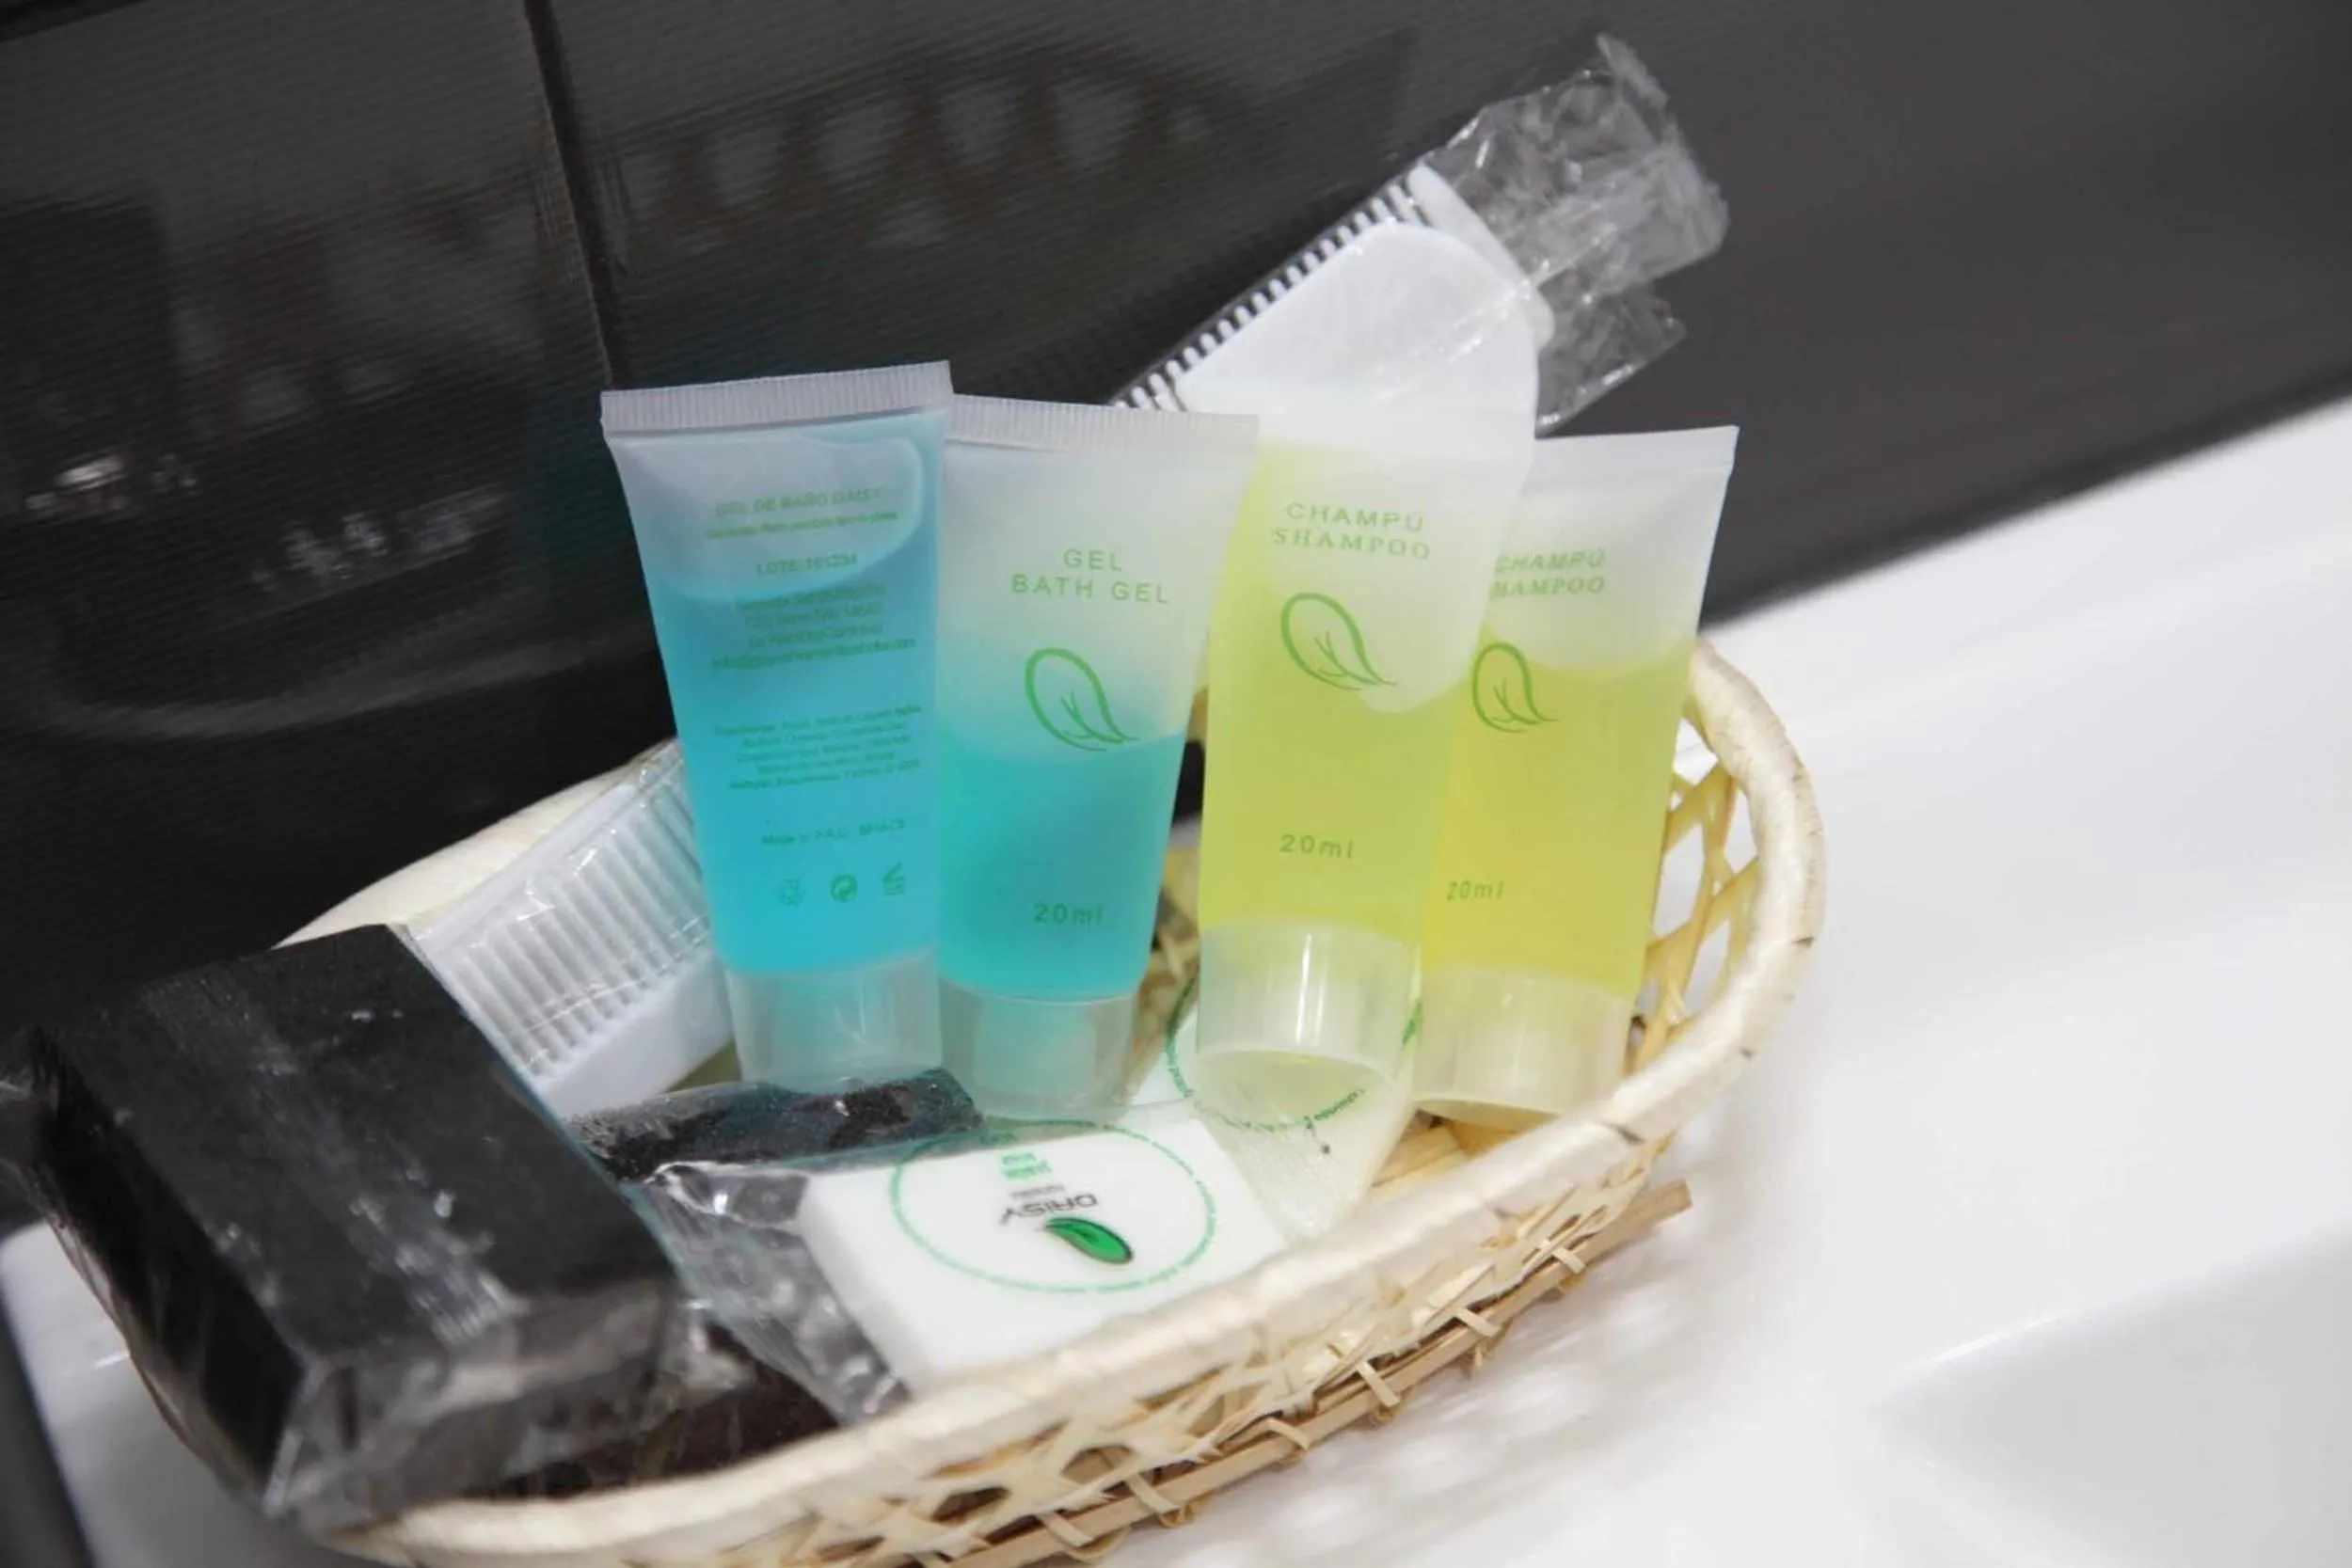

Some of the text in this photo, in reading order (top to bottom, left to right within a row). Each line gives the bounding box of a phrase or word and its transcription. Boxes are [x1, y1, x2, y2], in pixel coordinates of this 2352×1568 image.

[1273, 527, 1431, 560] SHAMPOO
[1063, 548, 1123, 572] GEL
[1010, 574, 1169, 604] BATH GEL
[1490, 577, 1605, 598] HAMPOO
[1279, 834, 1354, 860] 20ml
[1446, 880, 1504, 901] 20ml
[1035, 904, 1104, 925] 20ml
